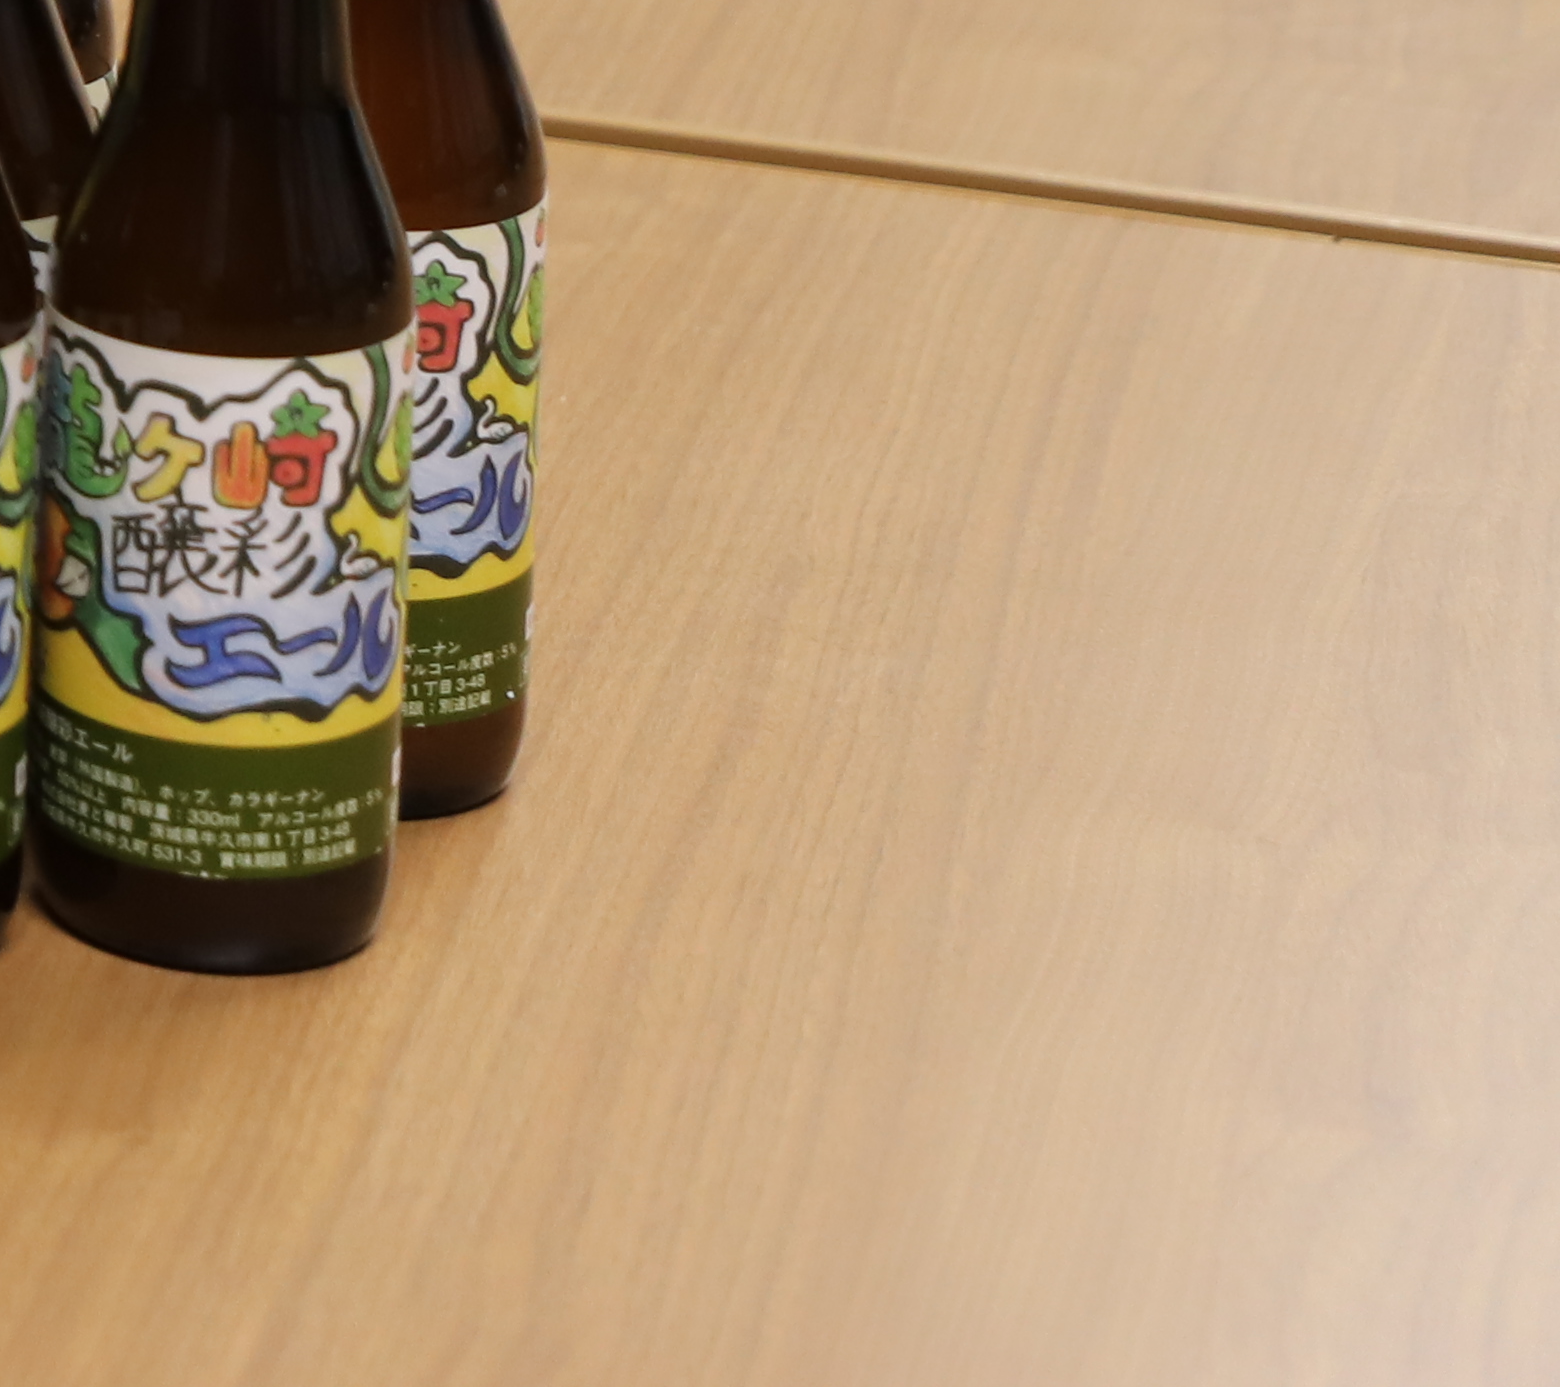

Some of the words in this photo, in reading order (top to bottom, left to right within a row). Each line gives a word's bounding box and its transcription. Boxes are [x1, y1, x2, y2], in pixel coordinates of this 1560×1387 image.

[410, 451, 528, 540] ール
[164, 584, 394, 690] エール
